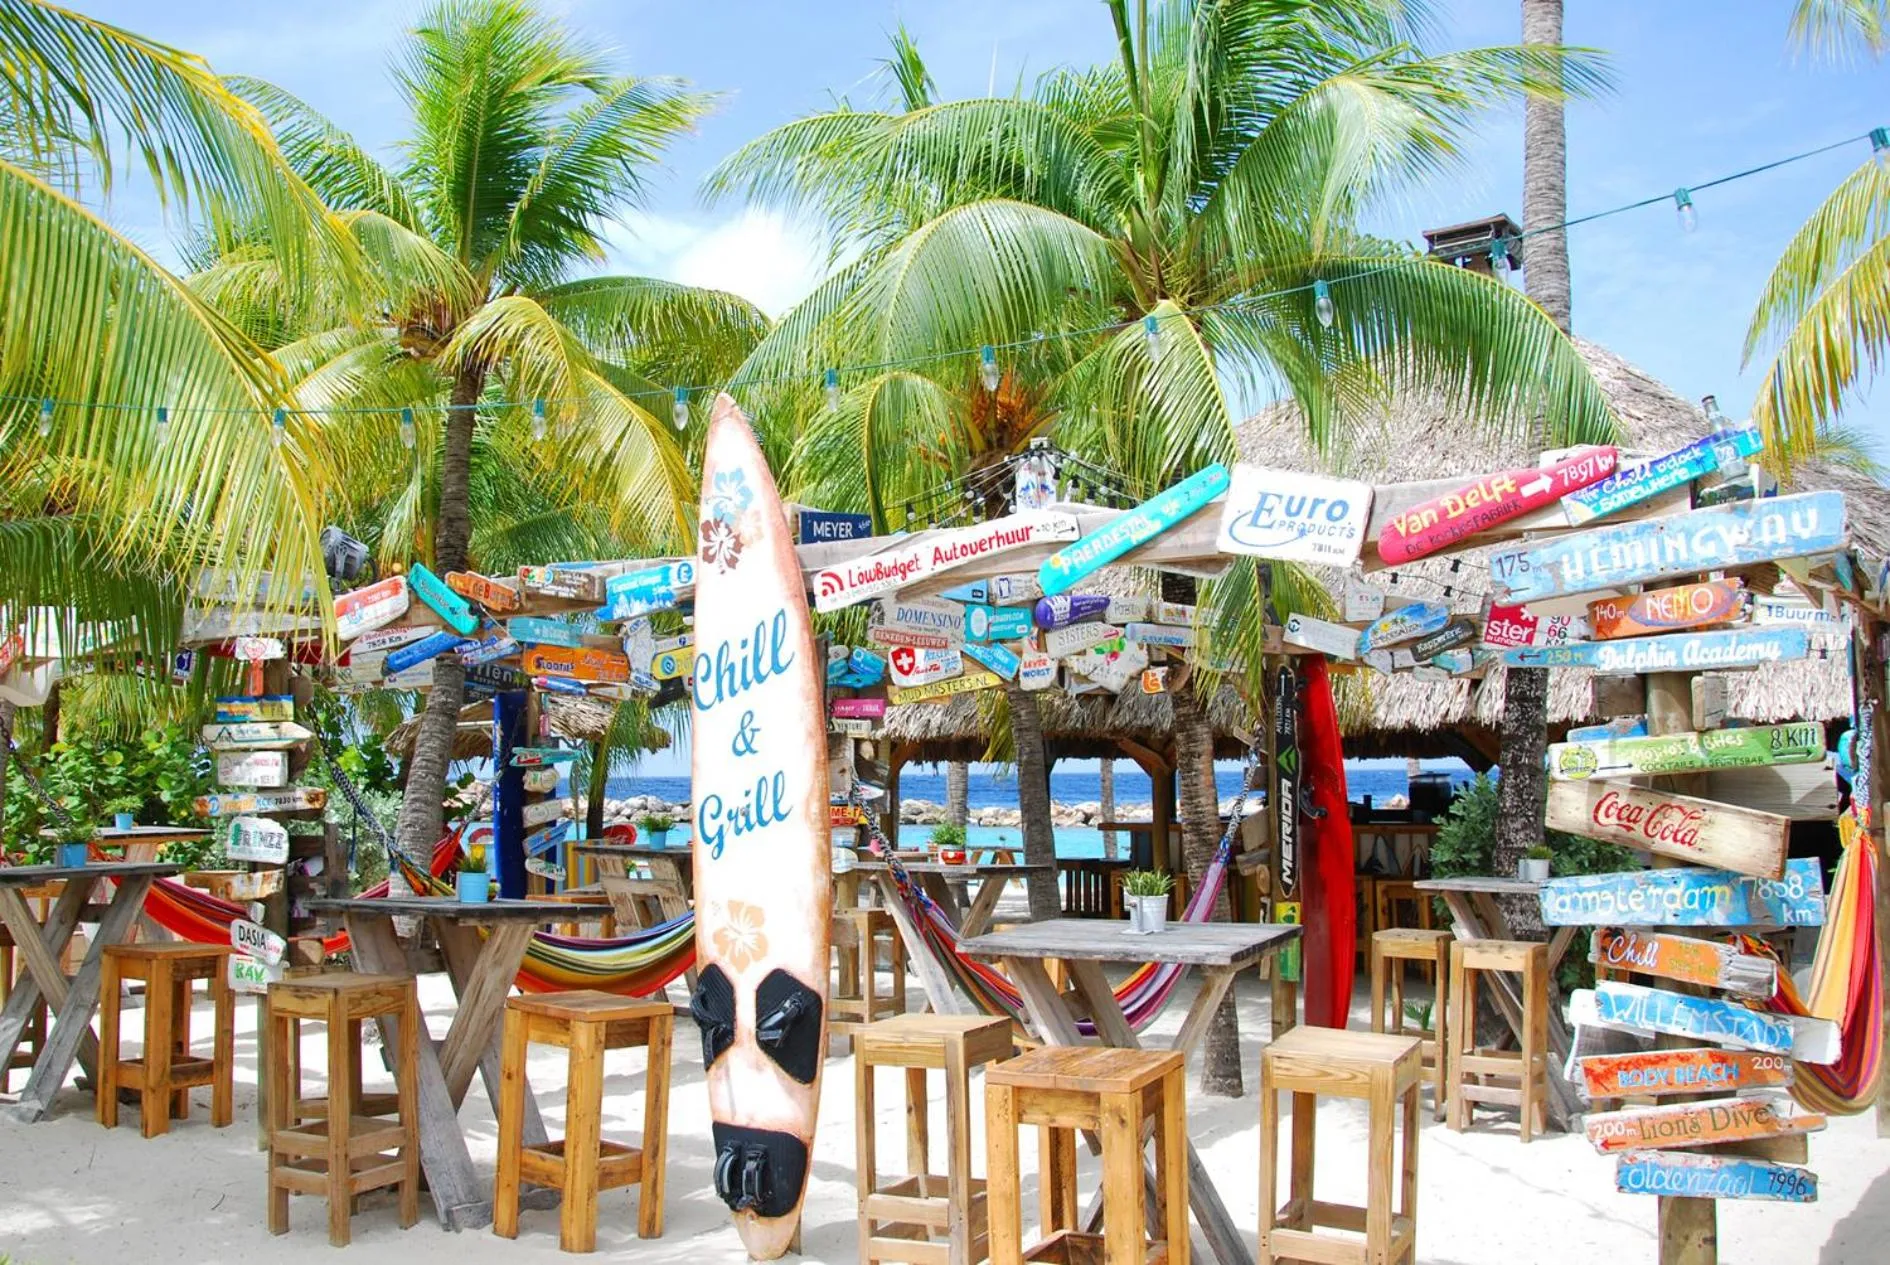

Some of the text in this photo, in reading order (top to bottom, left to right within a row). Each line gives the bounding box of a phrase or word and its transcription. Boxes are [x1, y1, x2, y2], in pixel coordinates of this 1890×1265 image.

[1602, 463, 1653, 495] Chill
[1248, 490, 1350, 530] Euro
[1393, 509, 1438, 538] Van
[1440, 475, 1517, 520] Delft
[1557, 459, 1596, 487] 7897
[812, 520, 854, 539] MEYER
[932, 524, 1035, 566] Autoverhuur
[1276, 519, 1357, 540] PRODUCTS
[1645, 586, 1715, 620] NEMO
[1487, 618, 1534, 643] ster
[693, 607, 796, 712] Chill
[1599, 641, 1676, 674] Dolphin
[1681, 636, 1784, 668] Academy
[732, 709, 762, 757] &
[1770, 728, 1782, 750] 8
[698, 770, 794, 861] Grill
[1281, 777, 1292, 885] MERIDA
[1555, 878, 1730, 916] amsterdam
[1782, 904, 1813, 923] km
[1606, 934, 1661, 968] Chill
[1607, 993, 1783, 1048] WILLEMSTAD
[1617, 1067, 1673, 1088] BODY
[1675, 1062, 1740, 1084] BEACH
[1703, 1102, 1774, 1133] Dive
[1767, 1170, 1807, 1196] 7996
